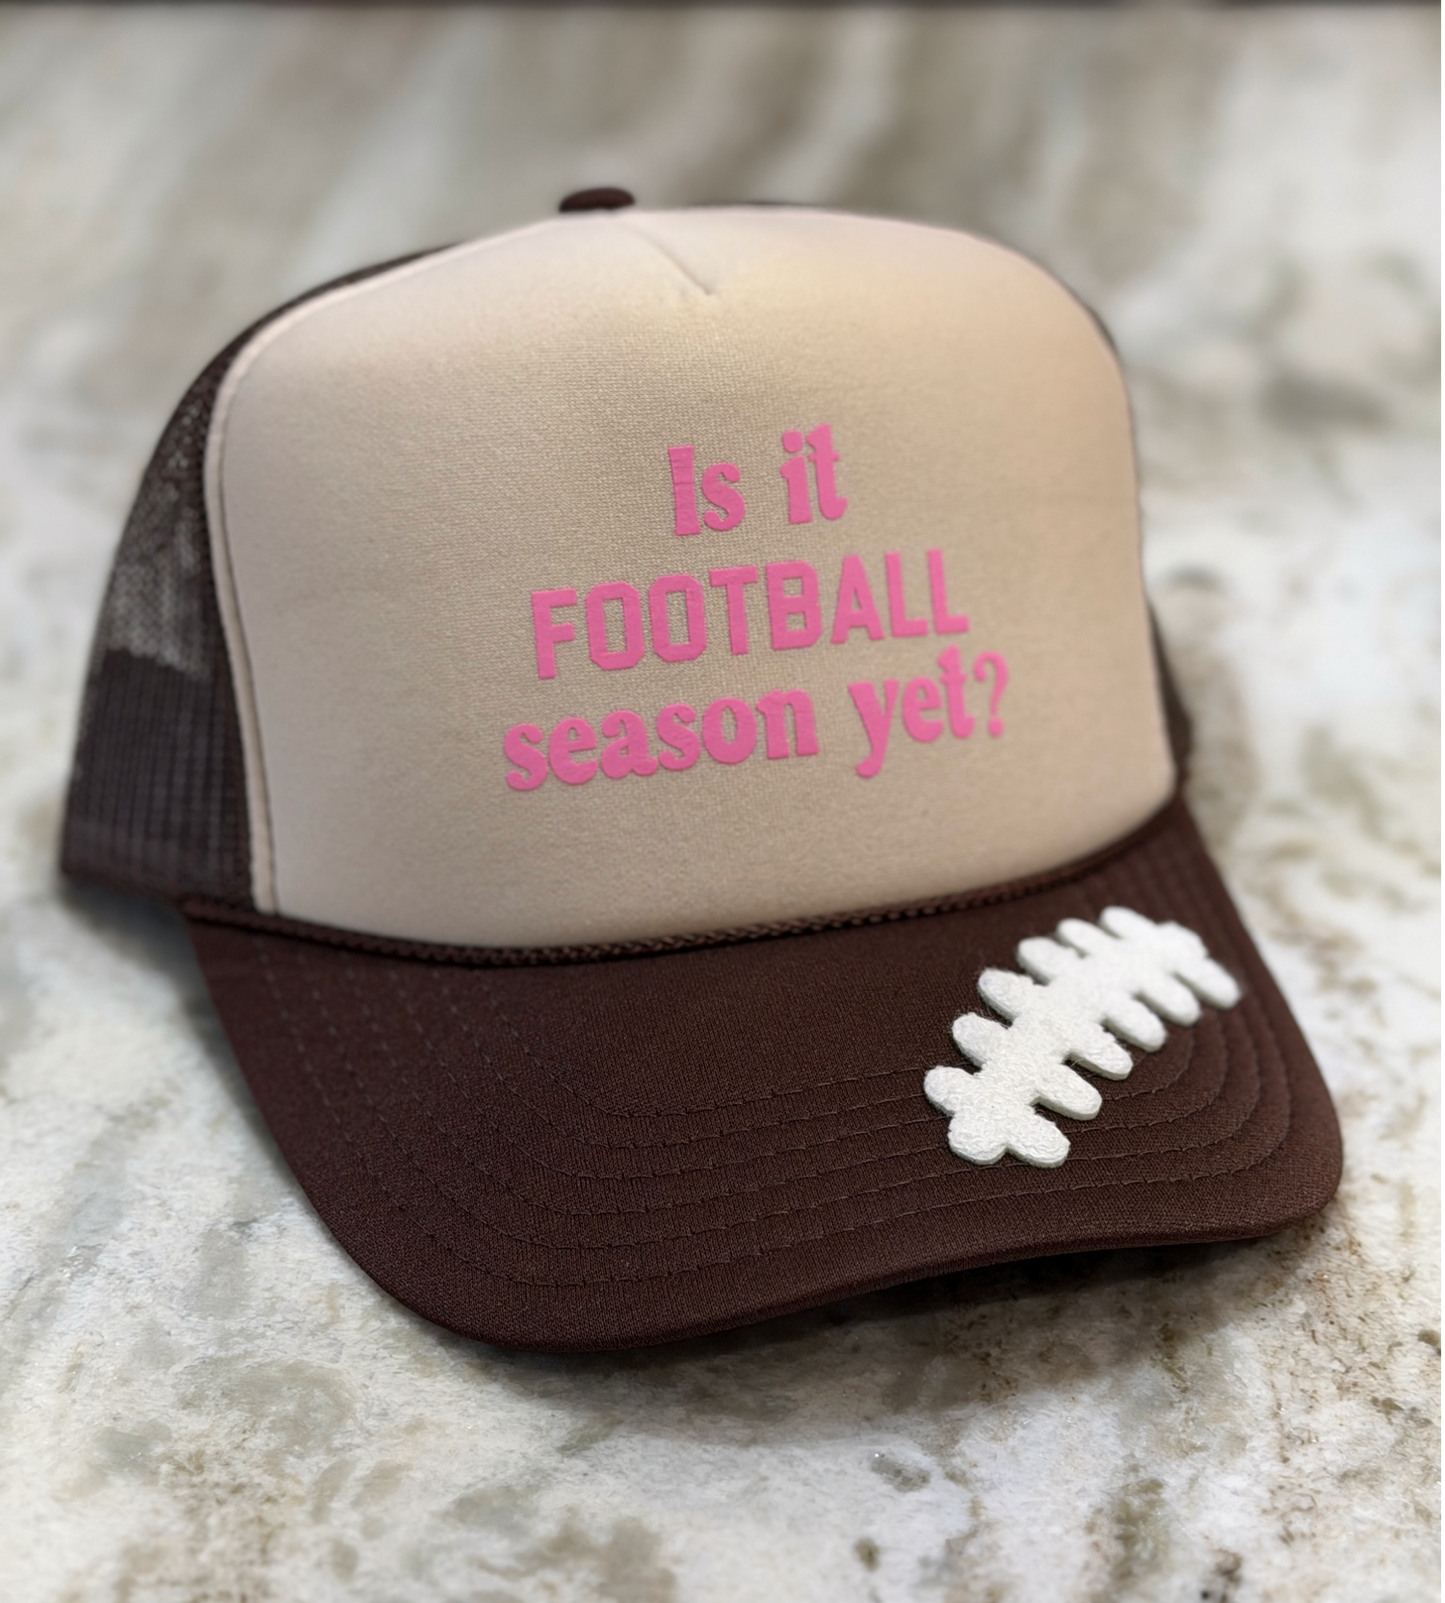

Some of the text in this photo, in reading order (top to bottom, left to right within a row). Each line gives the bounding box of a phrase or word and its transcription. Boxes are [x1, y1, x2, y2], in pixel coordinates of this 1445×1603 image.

[667, 423, 849, 537] Is it
[530, 548, 970, 680] FOOTBALL
[503, 644, 1010, 792] season yet?
